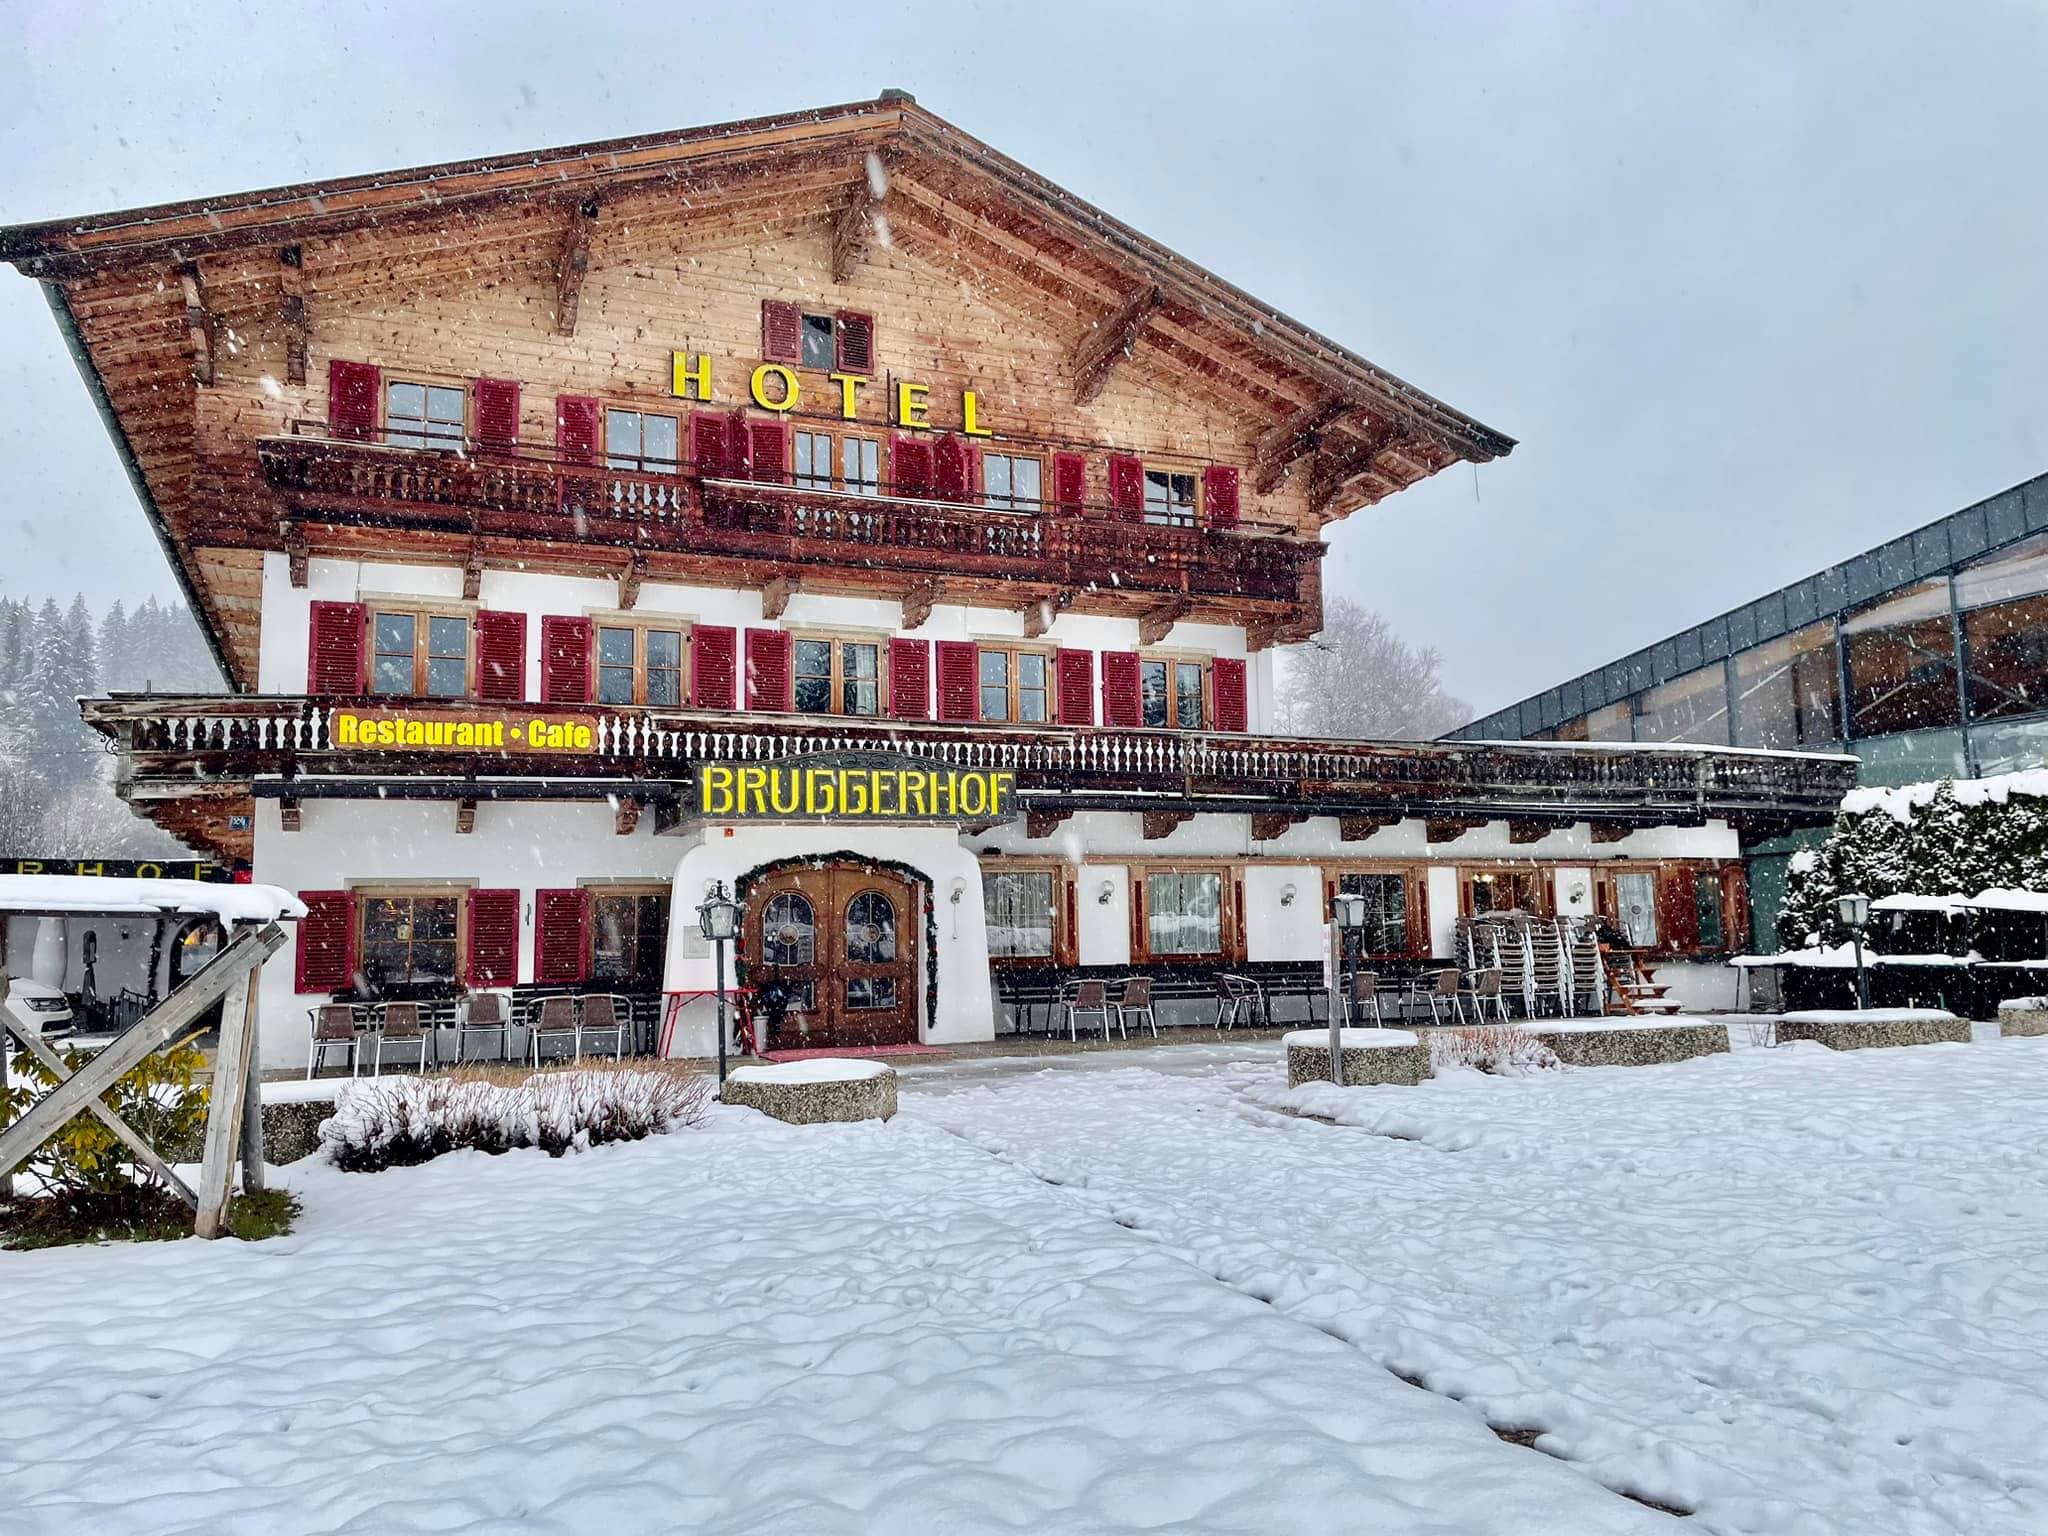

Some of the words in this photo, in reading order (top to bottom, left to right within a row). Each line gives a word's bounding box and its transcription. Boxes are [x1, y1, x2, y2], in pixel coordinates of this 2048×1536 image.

[671, 351, 993, 437] HOTEL
[338, 715, 504, 747] Restaurant
[528, 719, 592, 748] Cafe
[702, 767, 1014, 816] BRUGGERHOF
